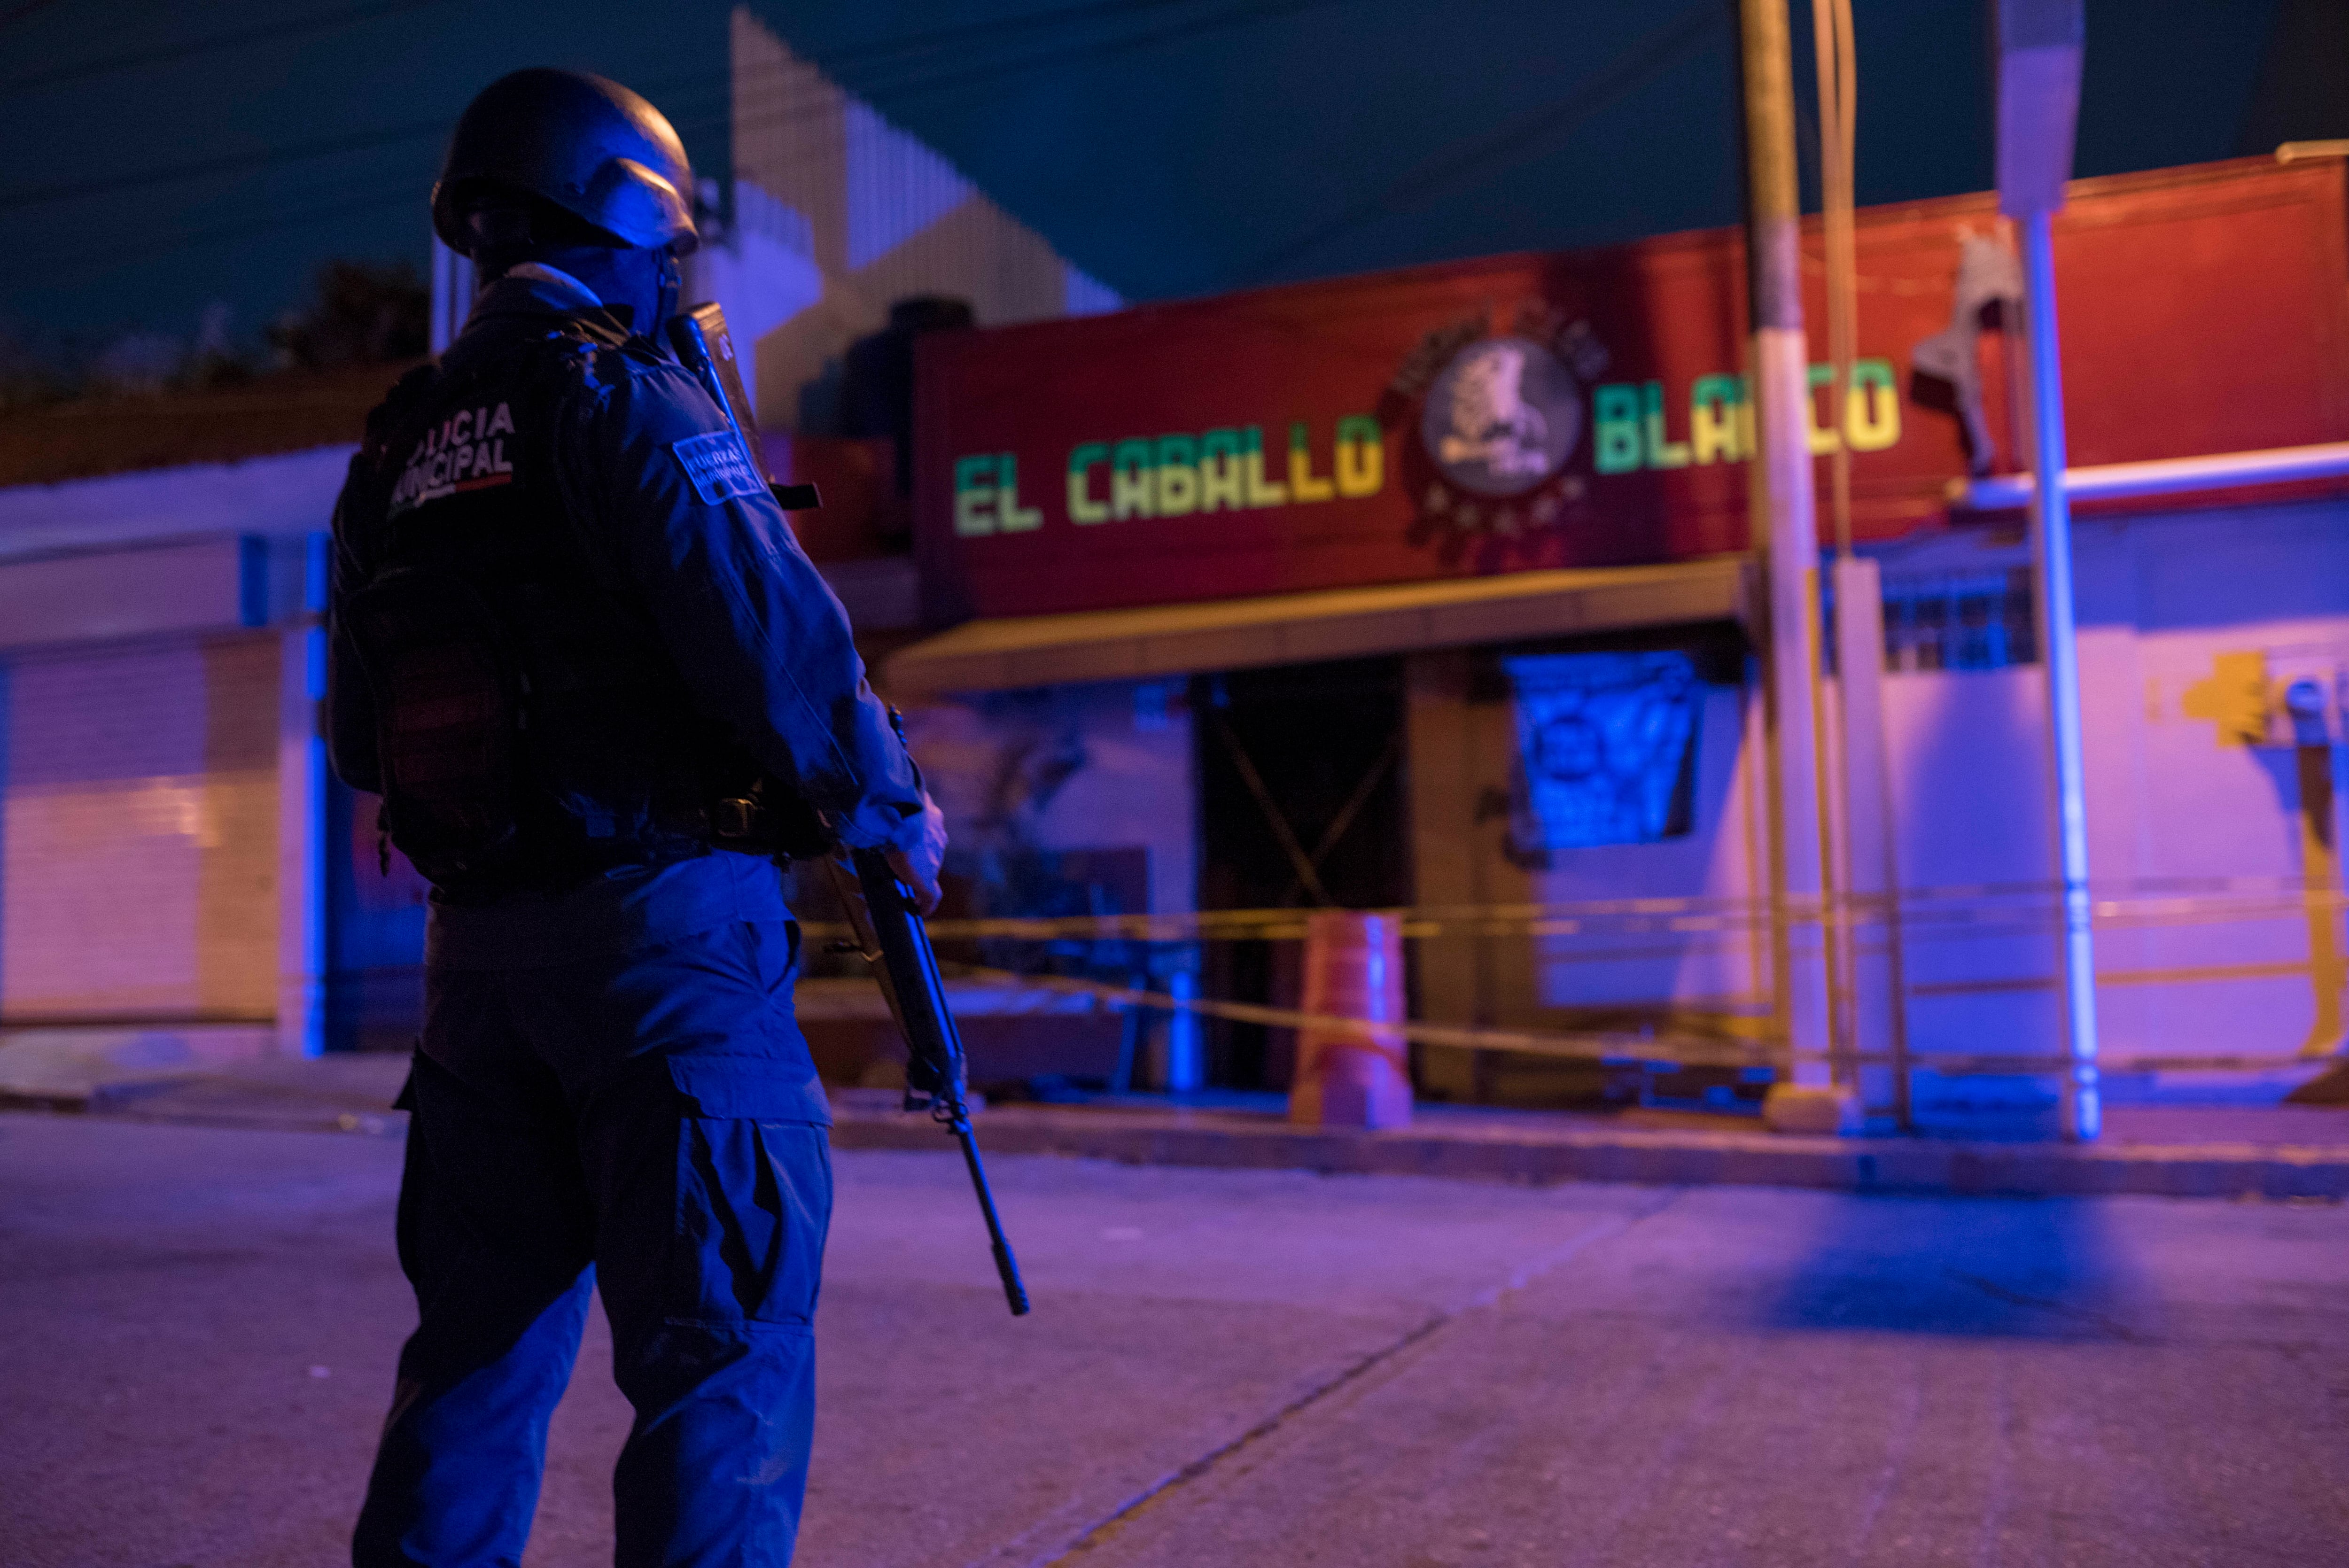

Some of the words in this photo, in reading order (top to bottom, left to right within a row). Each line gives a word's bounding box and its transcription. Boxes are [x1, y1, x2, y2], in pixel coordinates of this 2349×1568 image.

[956, 452, 1042, 536] EL
[1067, 415, 1383, 525] CABALLO
[1595, 358, 1900, 474] BLACO
